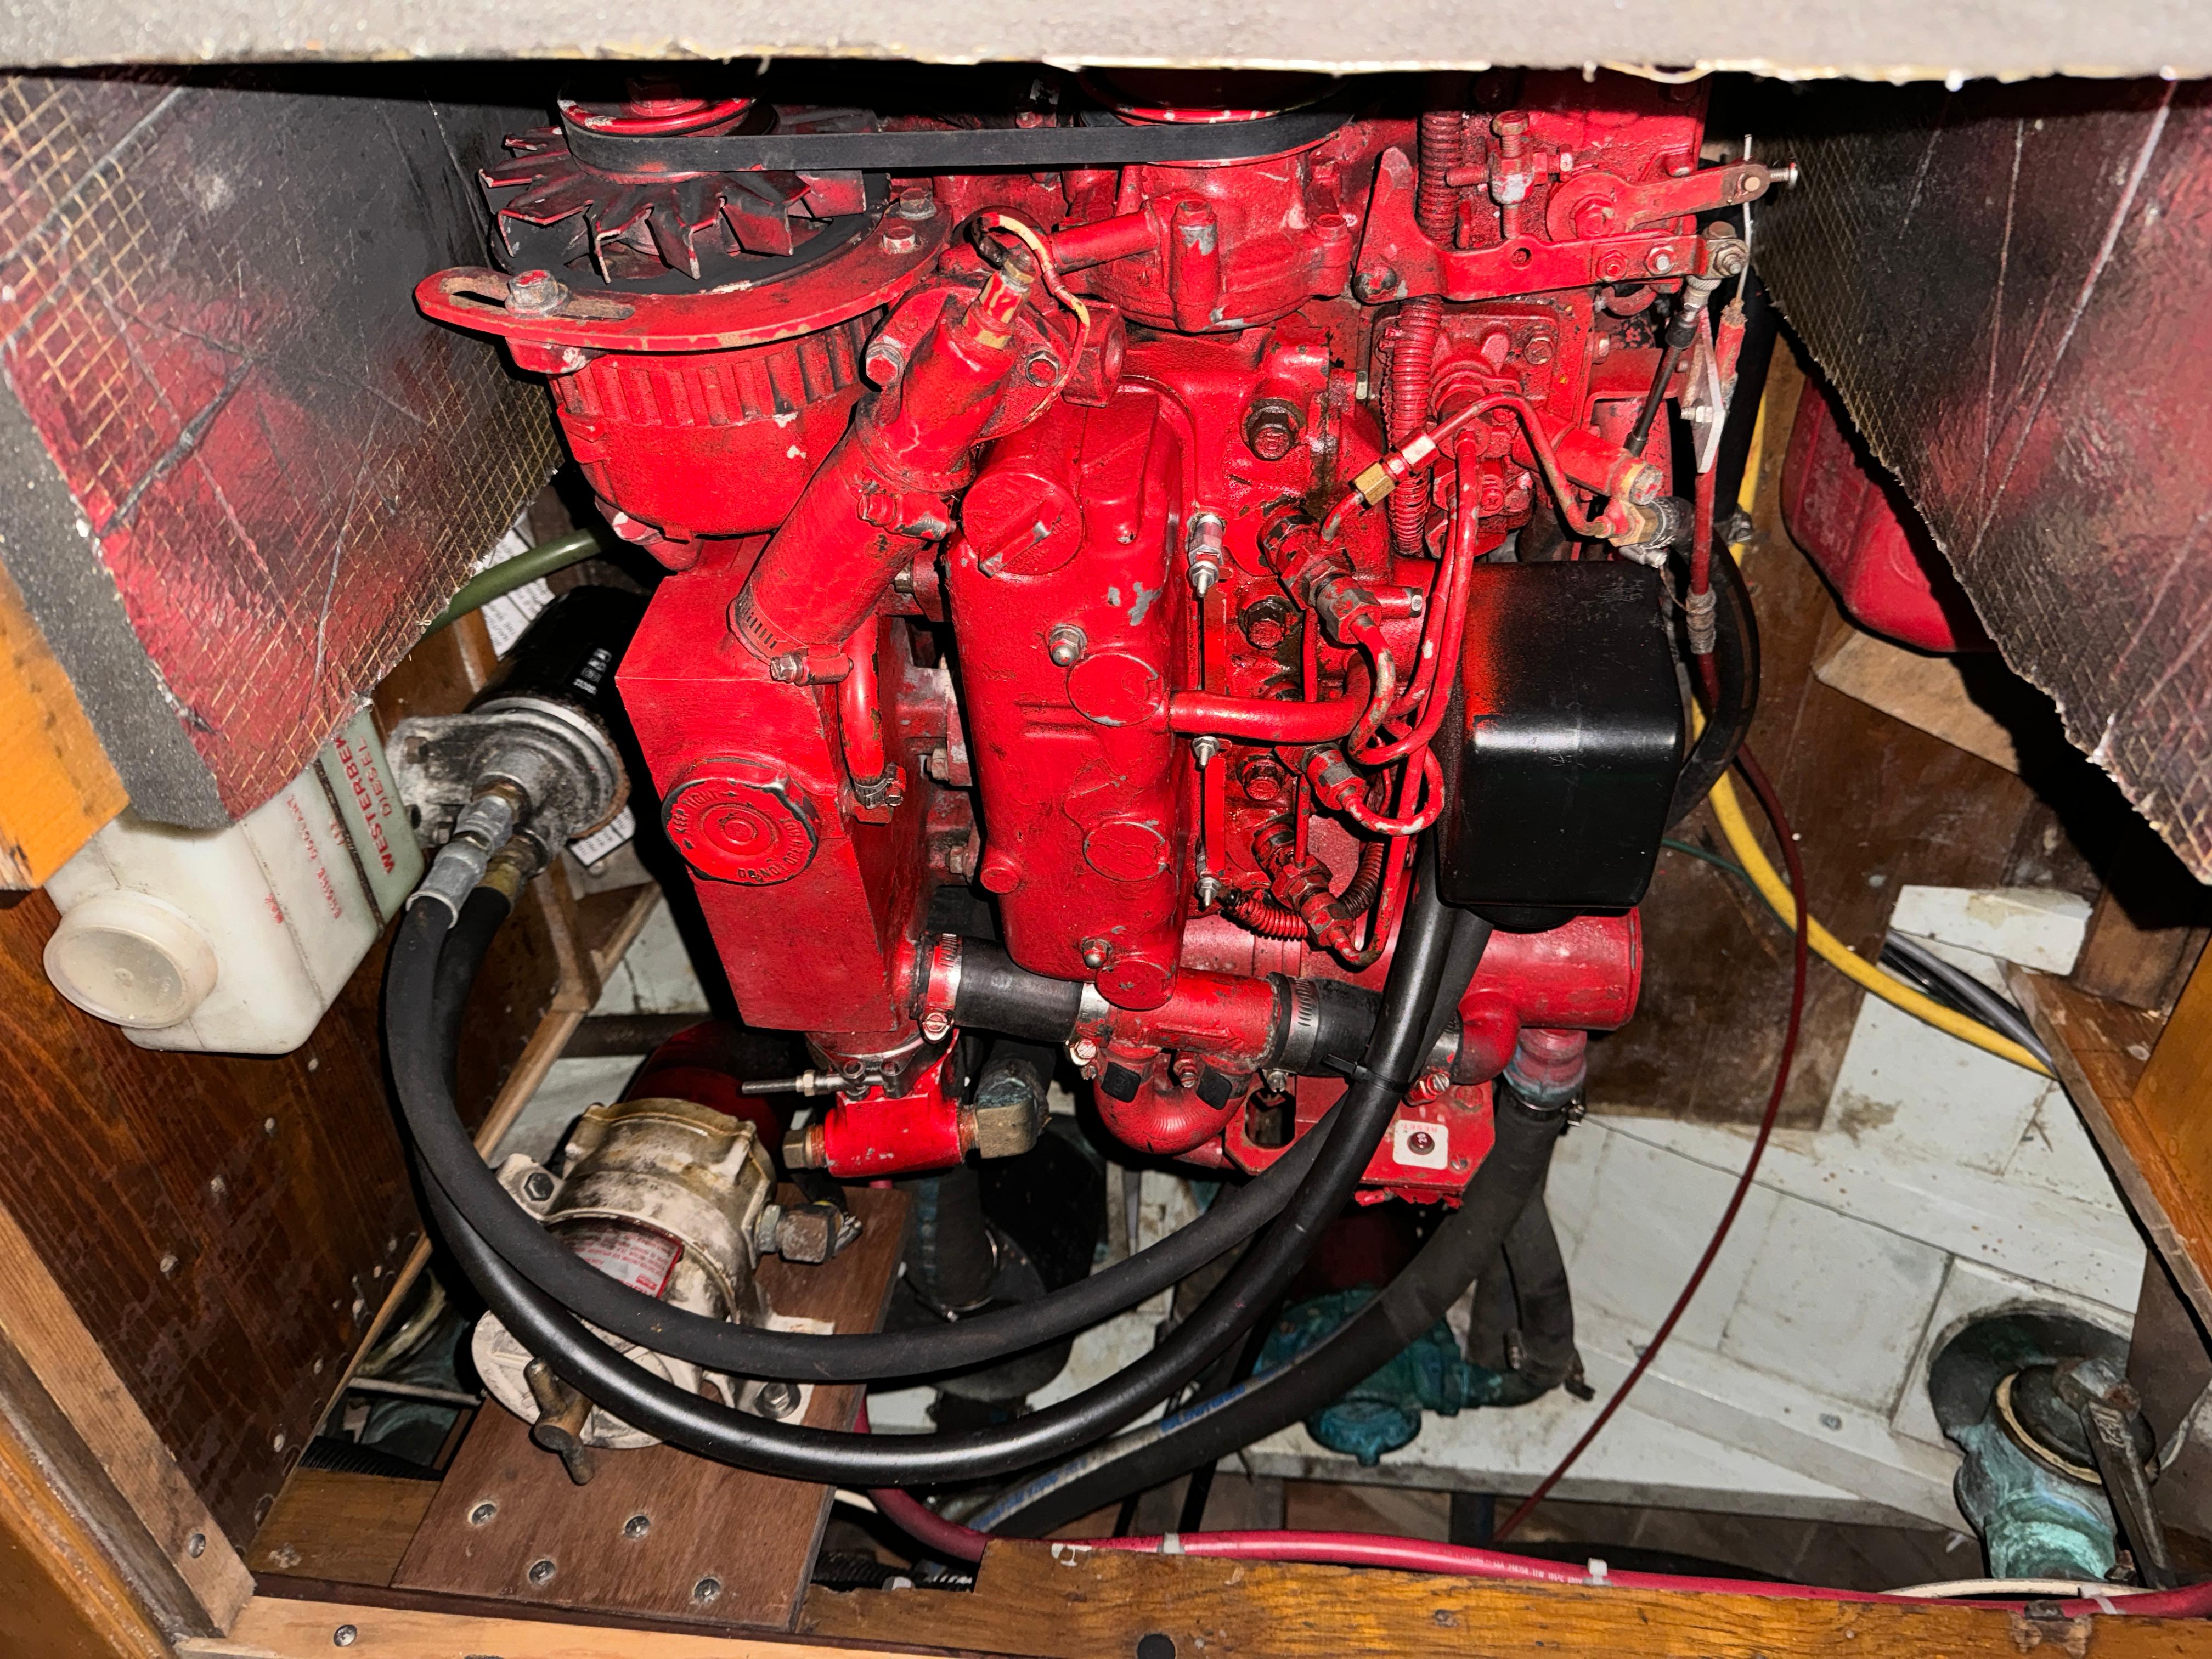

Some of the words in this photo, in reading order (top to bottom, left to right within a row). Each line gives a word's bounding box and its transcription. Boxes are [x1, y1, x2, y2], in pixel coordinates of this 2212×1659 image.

[357, 736, 392, 817] DIESEL
[673, 808, 687, 833] KEEP
[1404, 1123, 1437, 1132] RESET
[1417, 1133, 1427, 1143] 20
